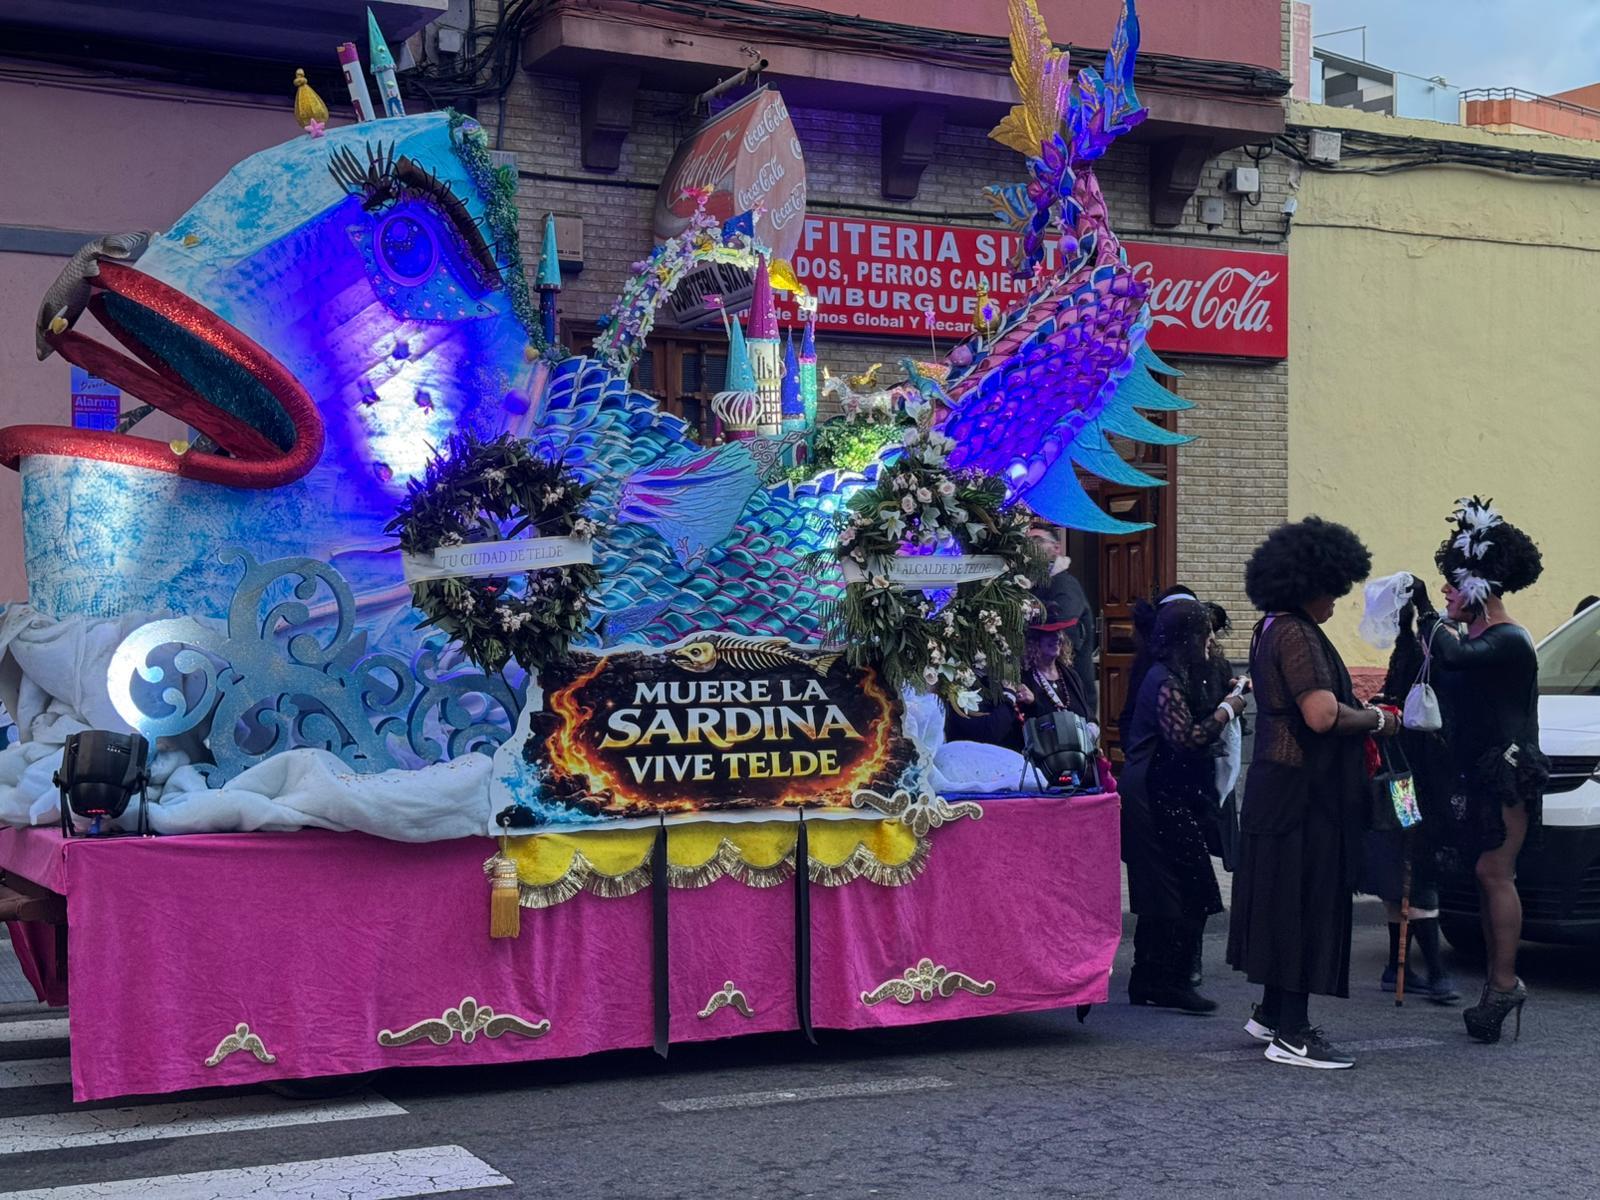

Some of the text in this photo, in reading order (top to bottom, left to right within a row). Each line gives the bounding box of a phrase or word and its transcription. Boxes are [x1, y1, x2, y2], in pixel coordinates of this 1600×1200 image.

[804, 220, 961, 264] FITERIA
[796, 256, 848, 286] DOS,
[857, 261, 942, 289] PERROS
[1131, 262, 1280, 332] Coca-Cola
[797, 309, 848, 324] Bonos
[853, 311, 904, 328] Global
[909, 316, 921, 329] Y
[75, 395, 117, 408] Alarma
[440, 545, 563, 569] TU CIUDAD DE TELDE
[902, 563, 949, 575] ALCALDE
[950, 563, 962, 575] DE
[632, 678, 830, 706] MUERE LA
[598, 703, 865, 750] SARDINA
[625, 749, 841, 784] VIVE TELDE
